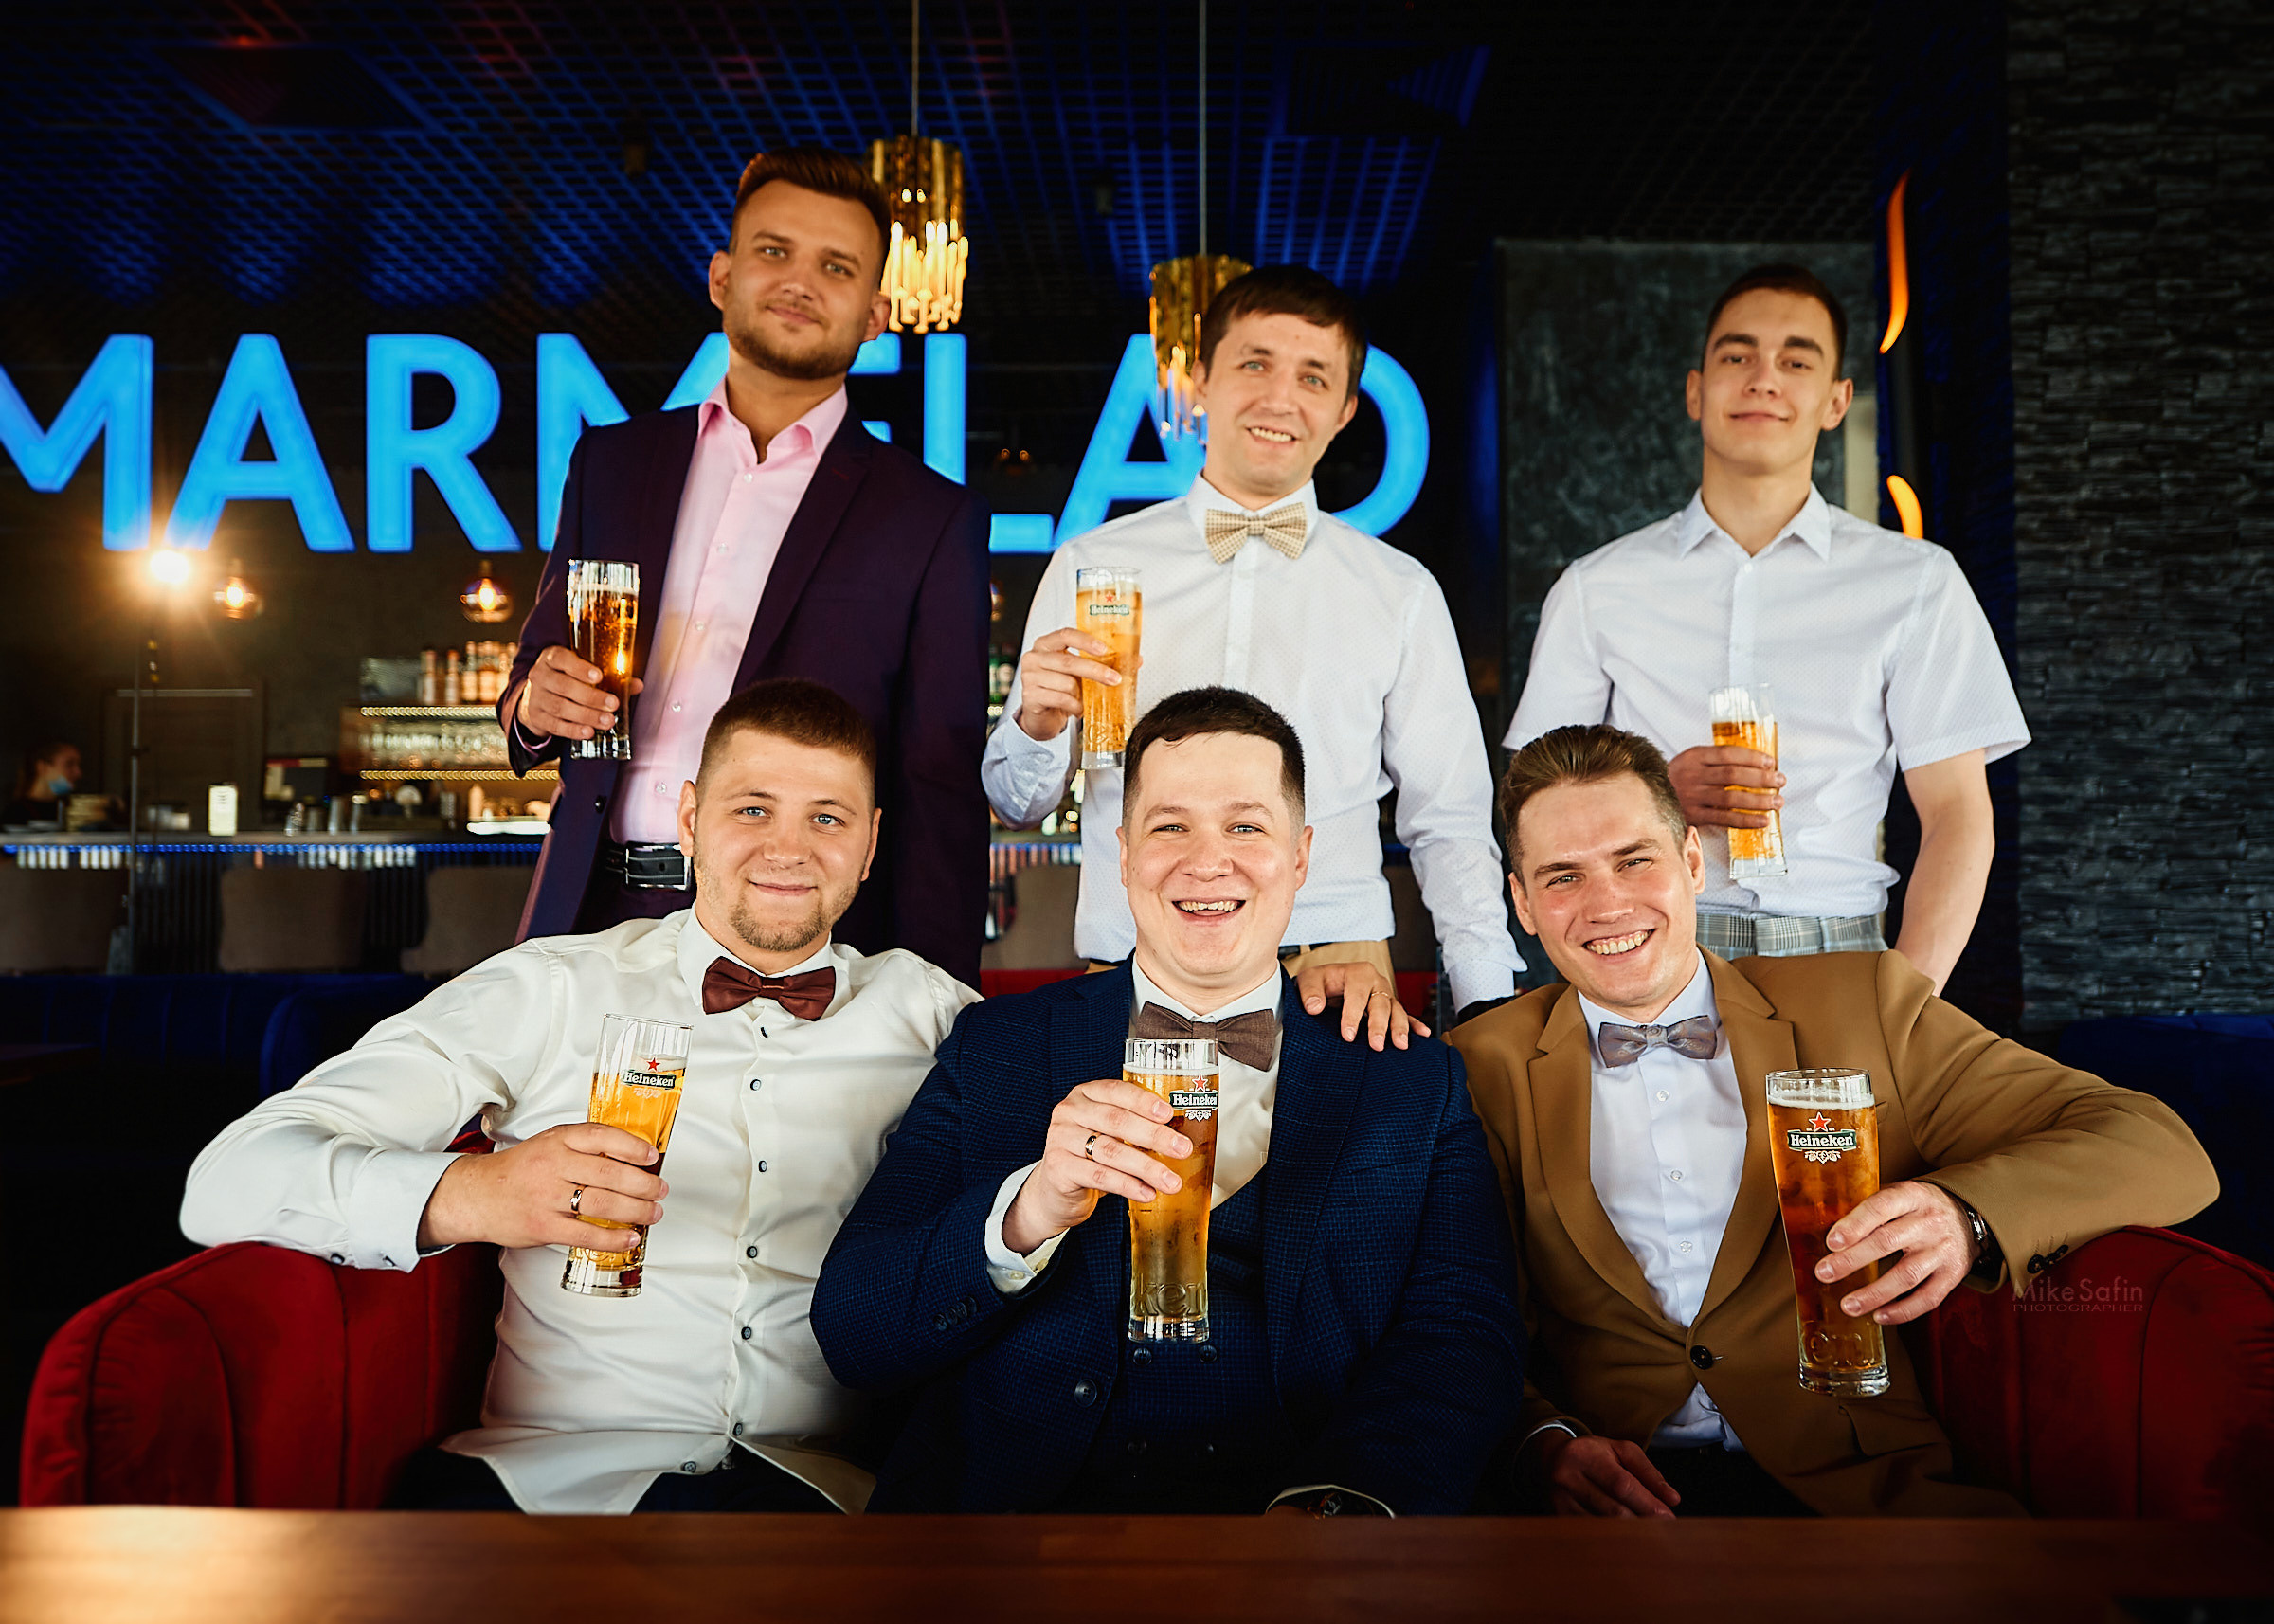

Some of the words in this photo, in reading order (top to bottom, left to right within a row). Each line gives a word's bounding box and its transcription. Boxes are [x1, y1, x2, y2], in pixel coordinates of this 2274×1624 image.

[0, 332, 1430, 554] MARMLAD
[623, 1072, 676, 1087] Heineken
[1172, 1093, 1218, 1106] Heineke
[1790, 1134, 1854, 1146] Heineken
